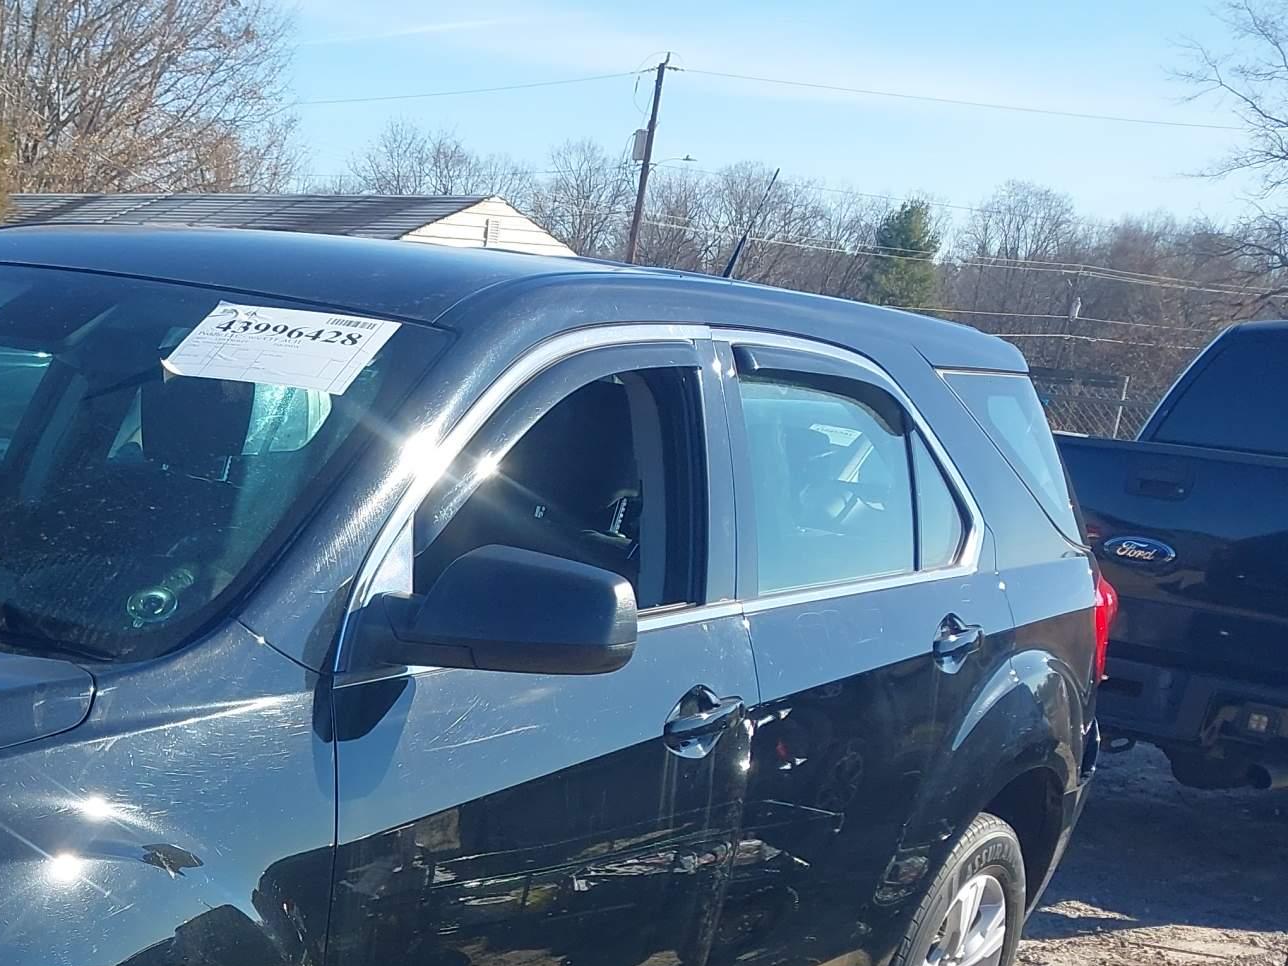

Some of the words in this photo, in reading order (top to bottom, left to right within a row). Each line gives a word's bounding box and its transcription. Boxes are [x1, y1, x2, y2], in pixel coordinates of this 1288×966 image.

[215, 319, 363, 347] 43996428
[1116, 540, 1157, 560] Ford
[965, 843, 1019, 881] ASSURA
